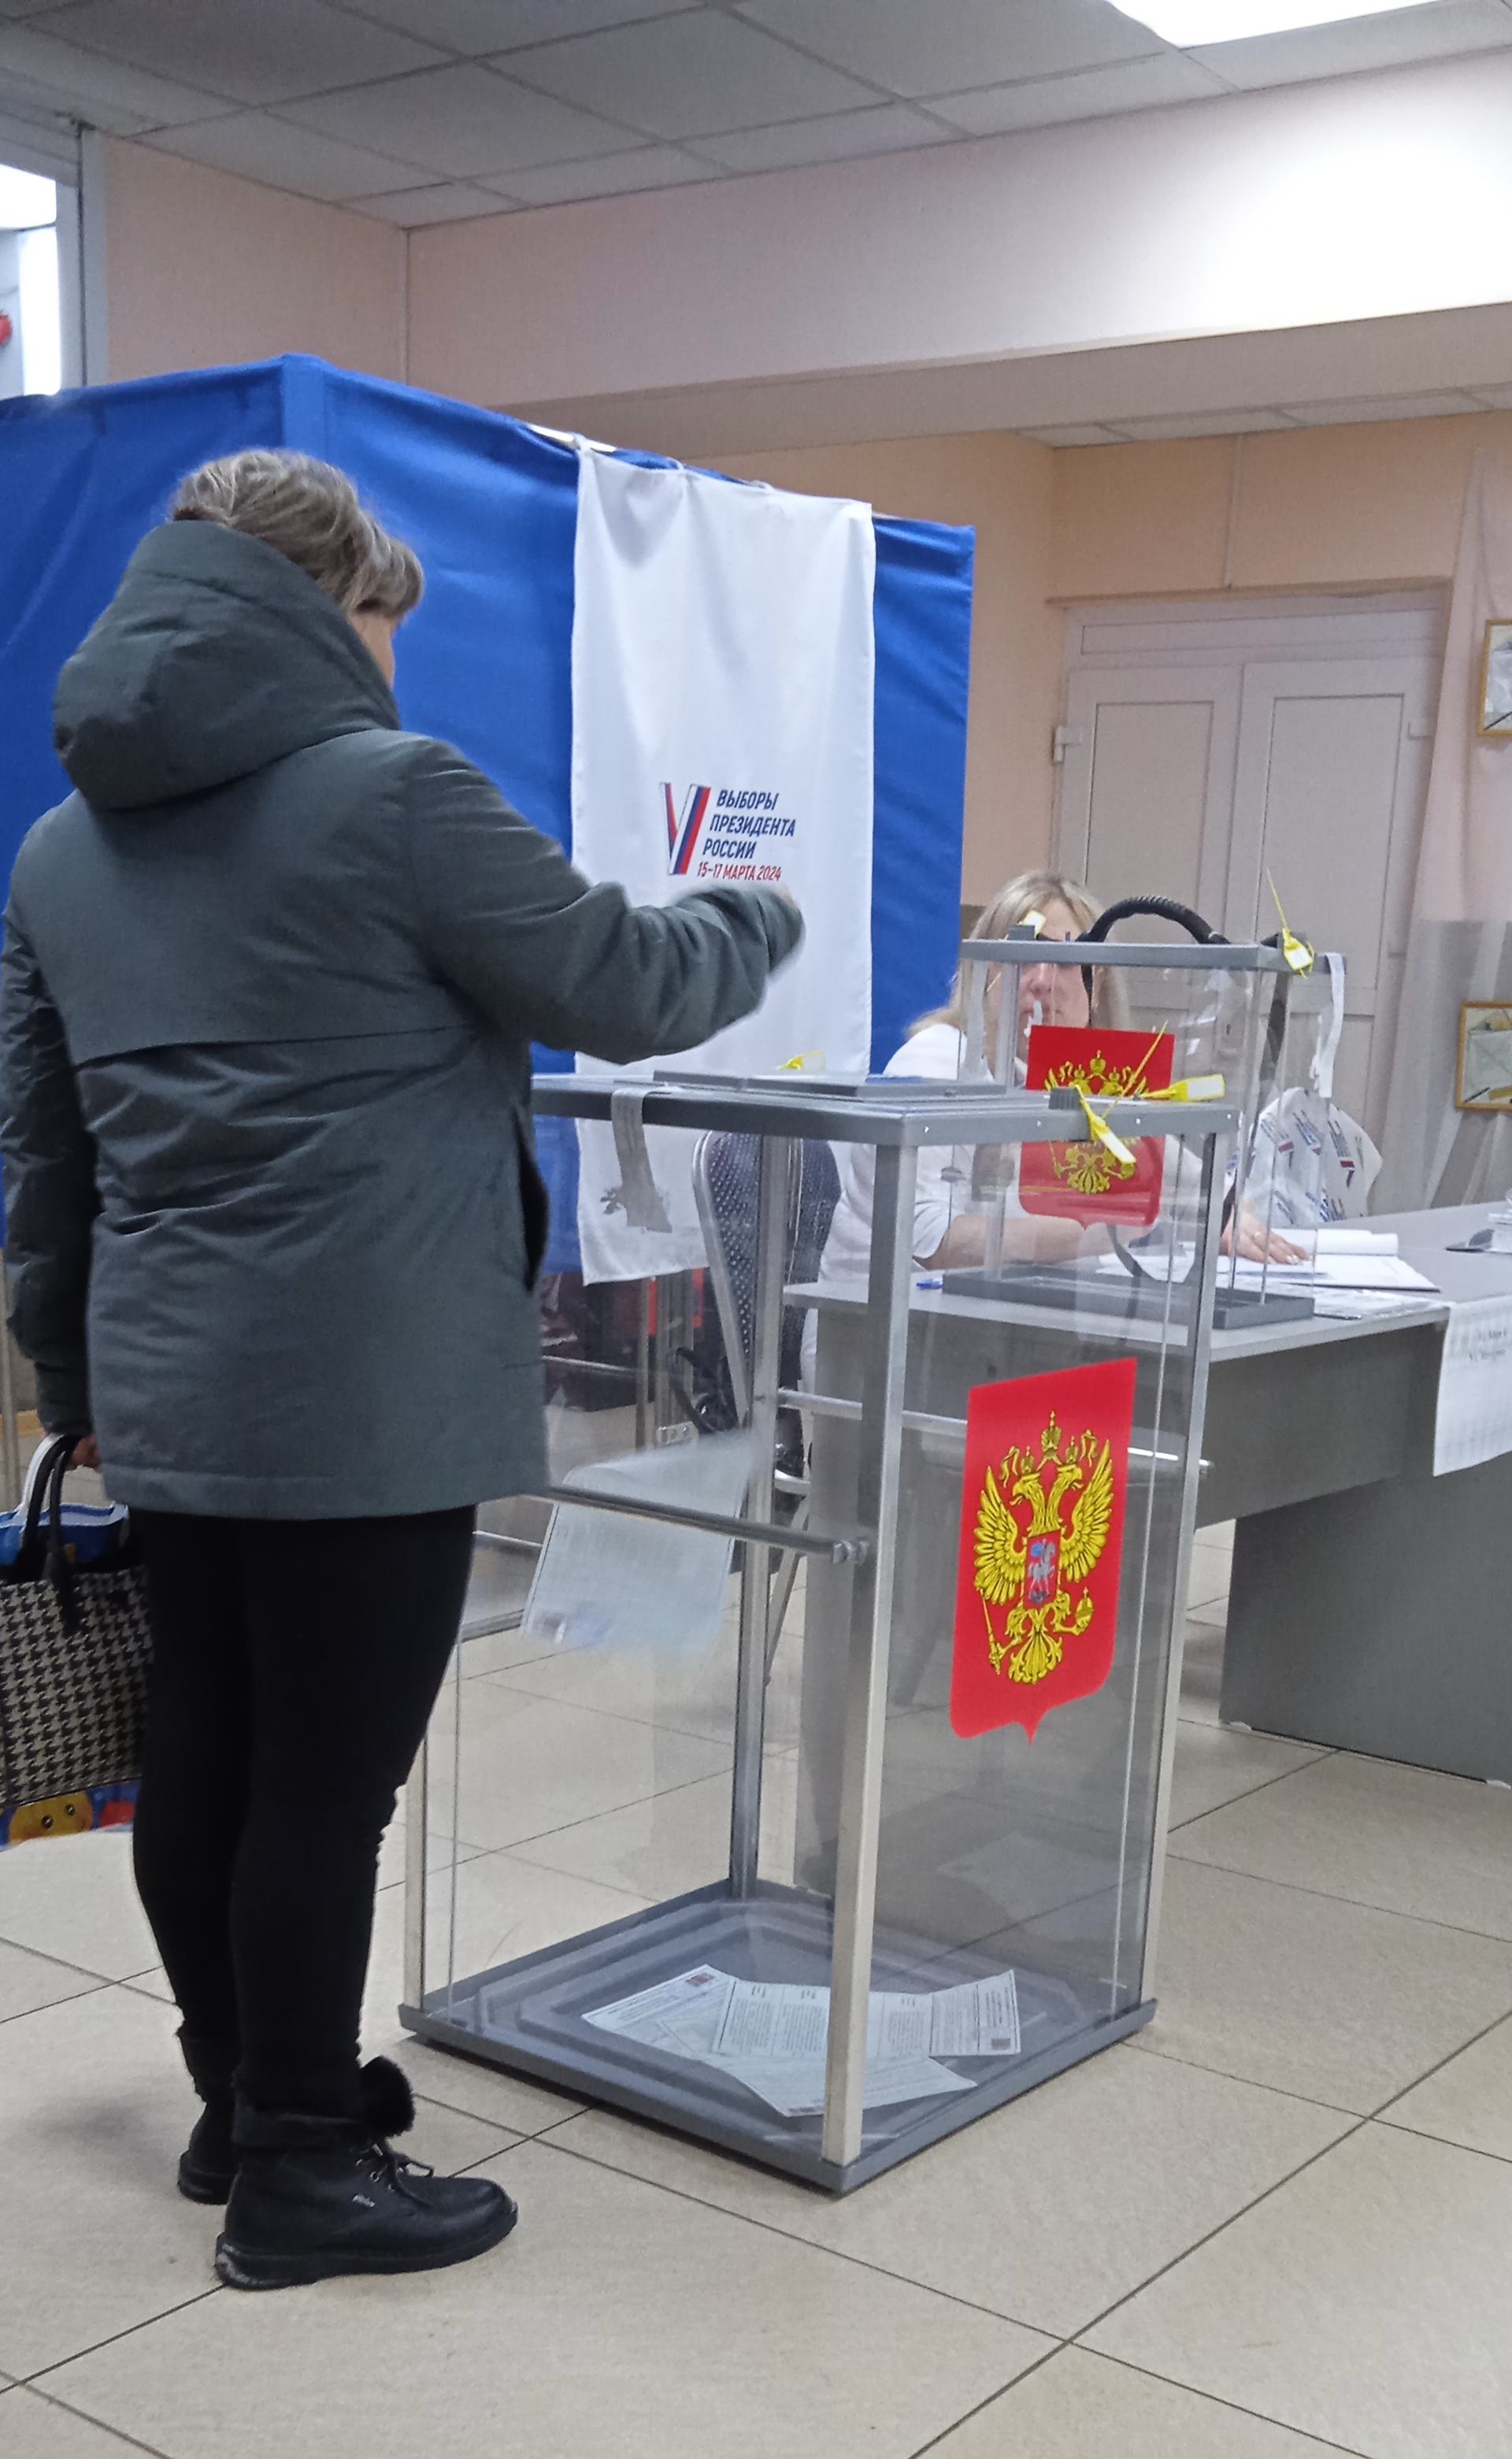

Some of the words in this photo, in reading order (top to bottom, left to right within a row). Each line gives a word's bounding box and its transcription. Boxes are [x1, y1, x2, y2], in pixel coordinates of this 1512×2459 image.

[716, 788, 779, 810] ВЫБОРЫ
[710, 813, 796, 837] ПРЕЗИДЕНТА
[702, 838, 757, 859] РОССИИ
[697, 861, 723, 879] 15-17
[722, 863, 755, 881] МАРТА
[756, 866, 781, 881] 2024
